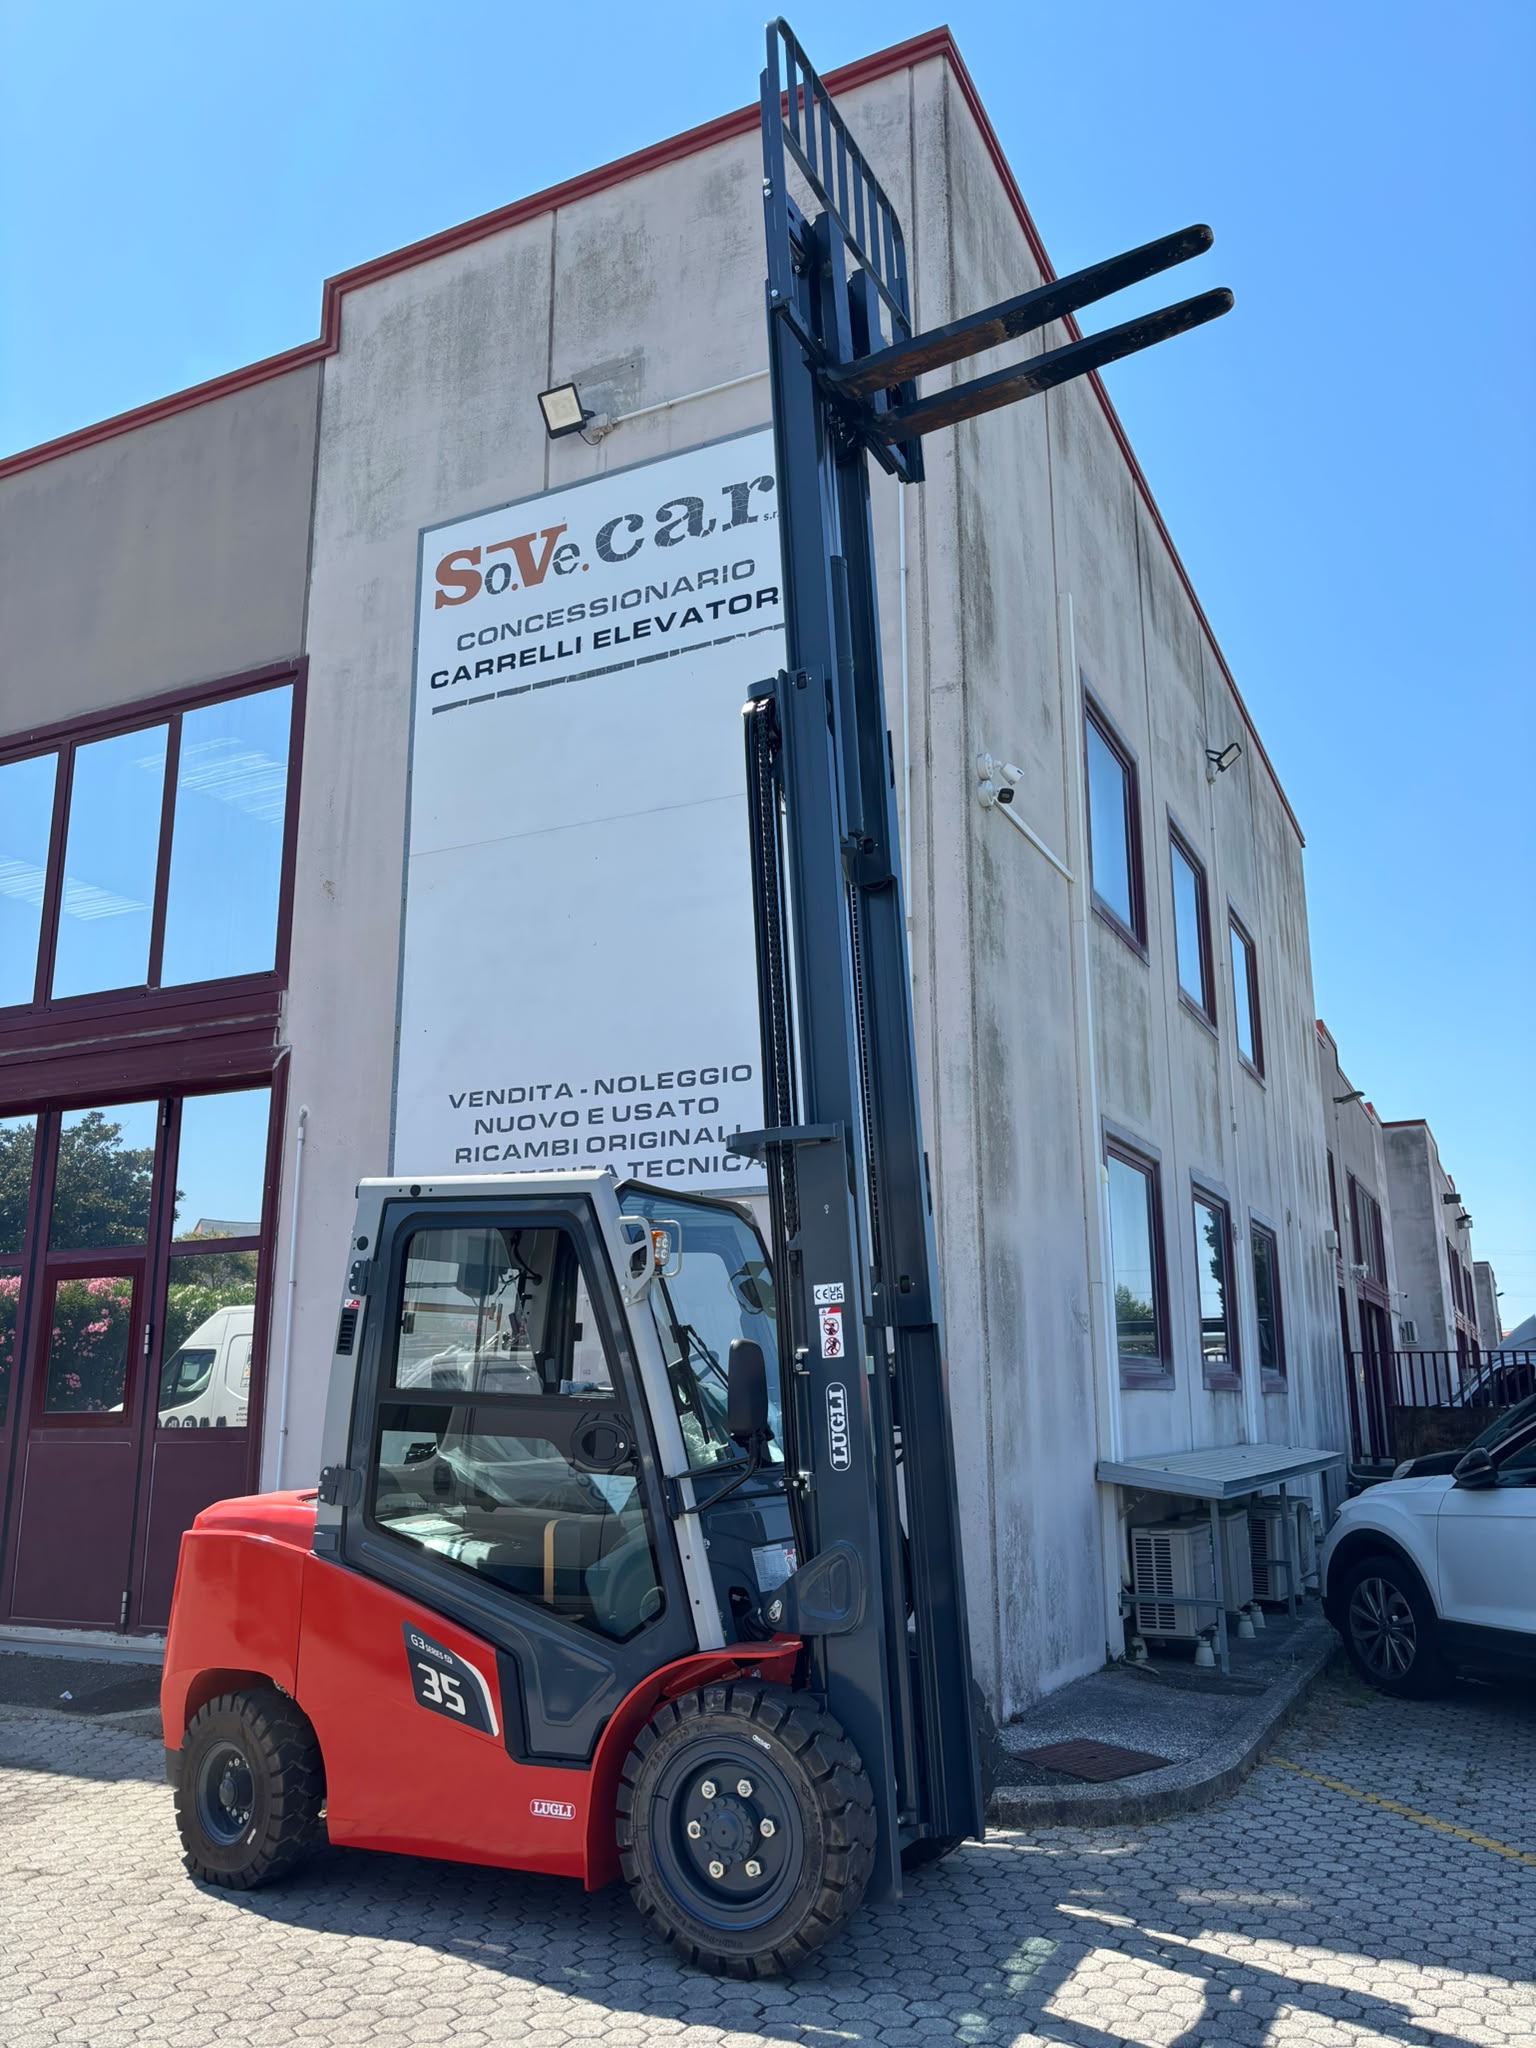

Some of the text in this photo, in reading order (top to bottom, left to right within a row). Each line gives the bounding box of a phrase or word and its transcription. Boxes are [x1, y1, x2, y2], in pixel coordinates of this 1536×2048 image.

[456, 559, 756, 651] CONCESSIONARIO
[430, 586, 779, 689] CARRELLI ELEVATOR
[449, 1083, 573, 1109] VENDITA
[594, 1064, 752, 1096] NOLEGGIO
[474, 1097, 720, 1136] NUOVO E USATO
[455, 1138, 578, 1164] RICAMBI
[829, 1389, 848, 1464] LUGLI
[410, 1633, 425, 1650] G3
[417, 1662, 466, 1716] 35
[533, 1801, 572, 1818] LUGLI
